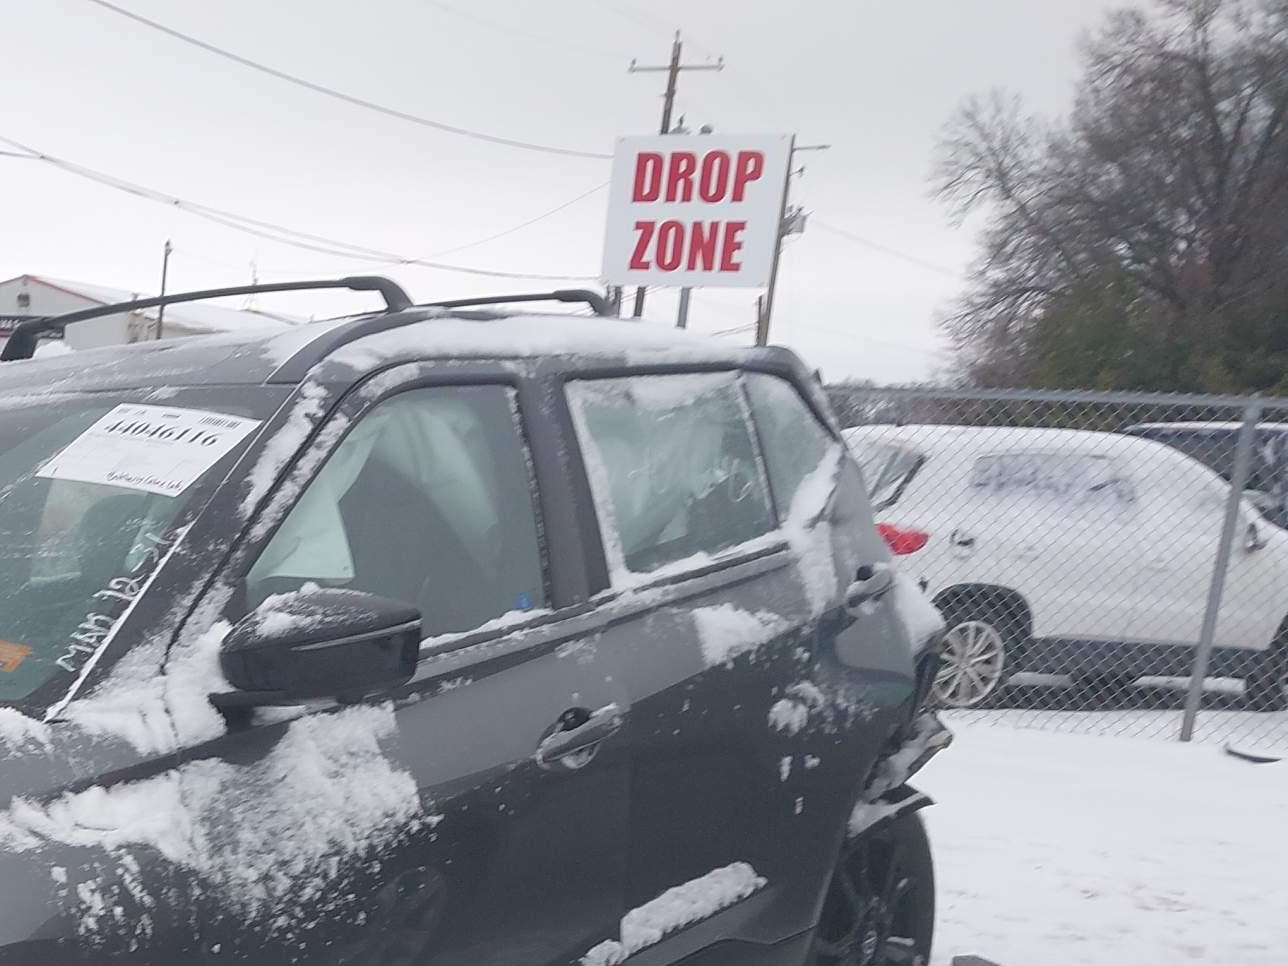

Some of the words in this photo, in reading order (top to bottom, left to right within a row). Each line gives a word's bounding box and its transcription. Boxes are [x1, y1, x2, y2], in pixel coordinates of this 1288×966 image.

[632, 150, 764, 203] DROP
[629, 220, 746, 273] ZONE
[105, 420, 218, 447] 44046116
